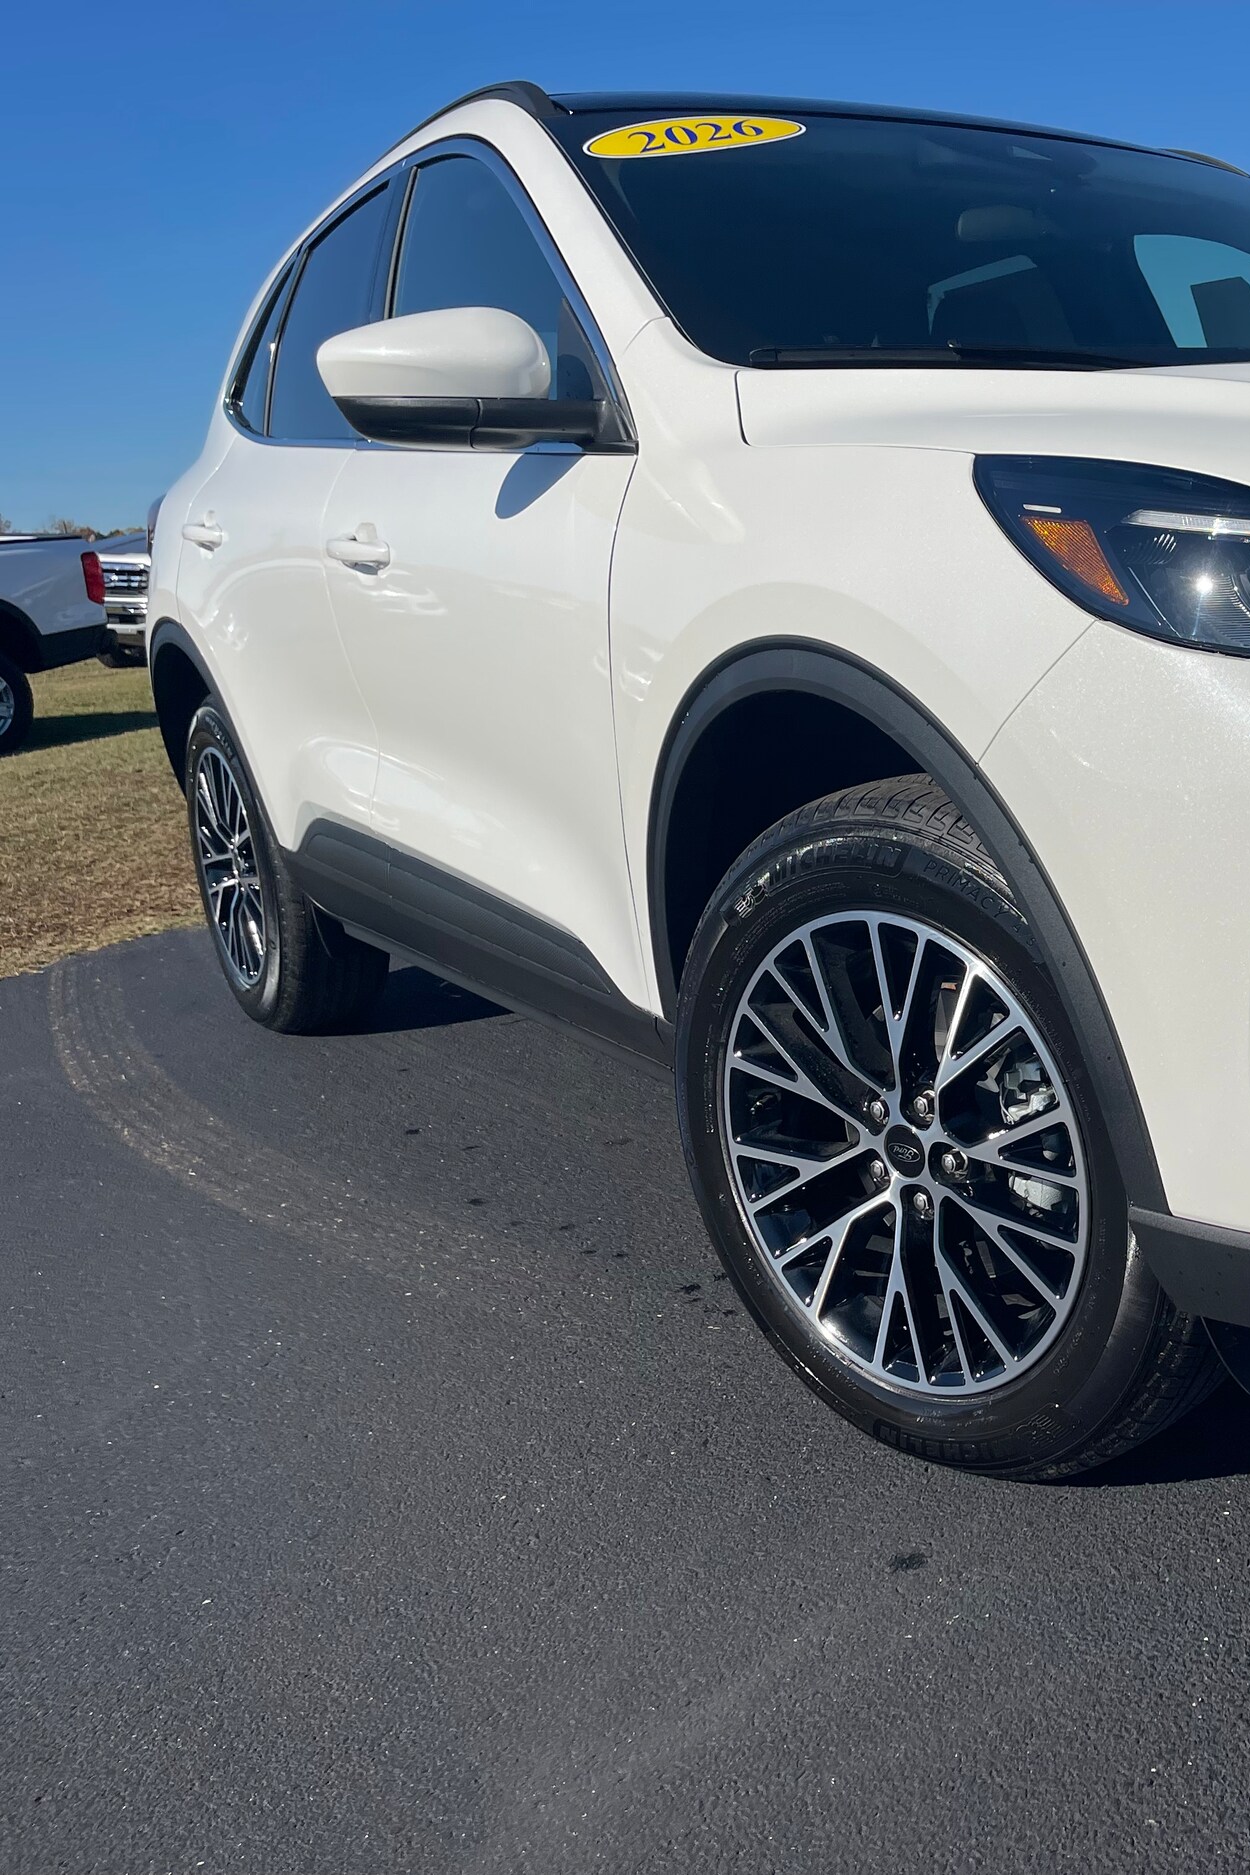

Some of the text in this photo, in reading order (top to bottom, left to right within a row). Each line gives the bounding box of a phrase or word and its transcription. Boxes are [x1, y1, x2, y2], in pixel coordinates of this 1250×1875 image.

[627, 118, 764, 154] 2026
[921, 859, 1011, 919] PRIMACY
[892, 1144, 915, 1162] Ford
